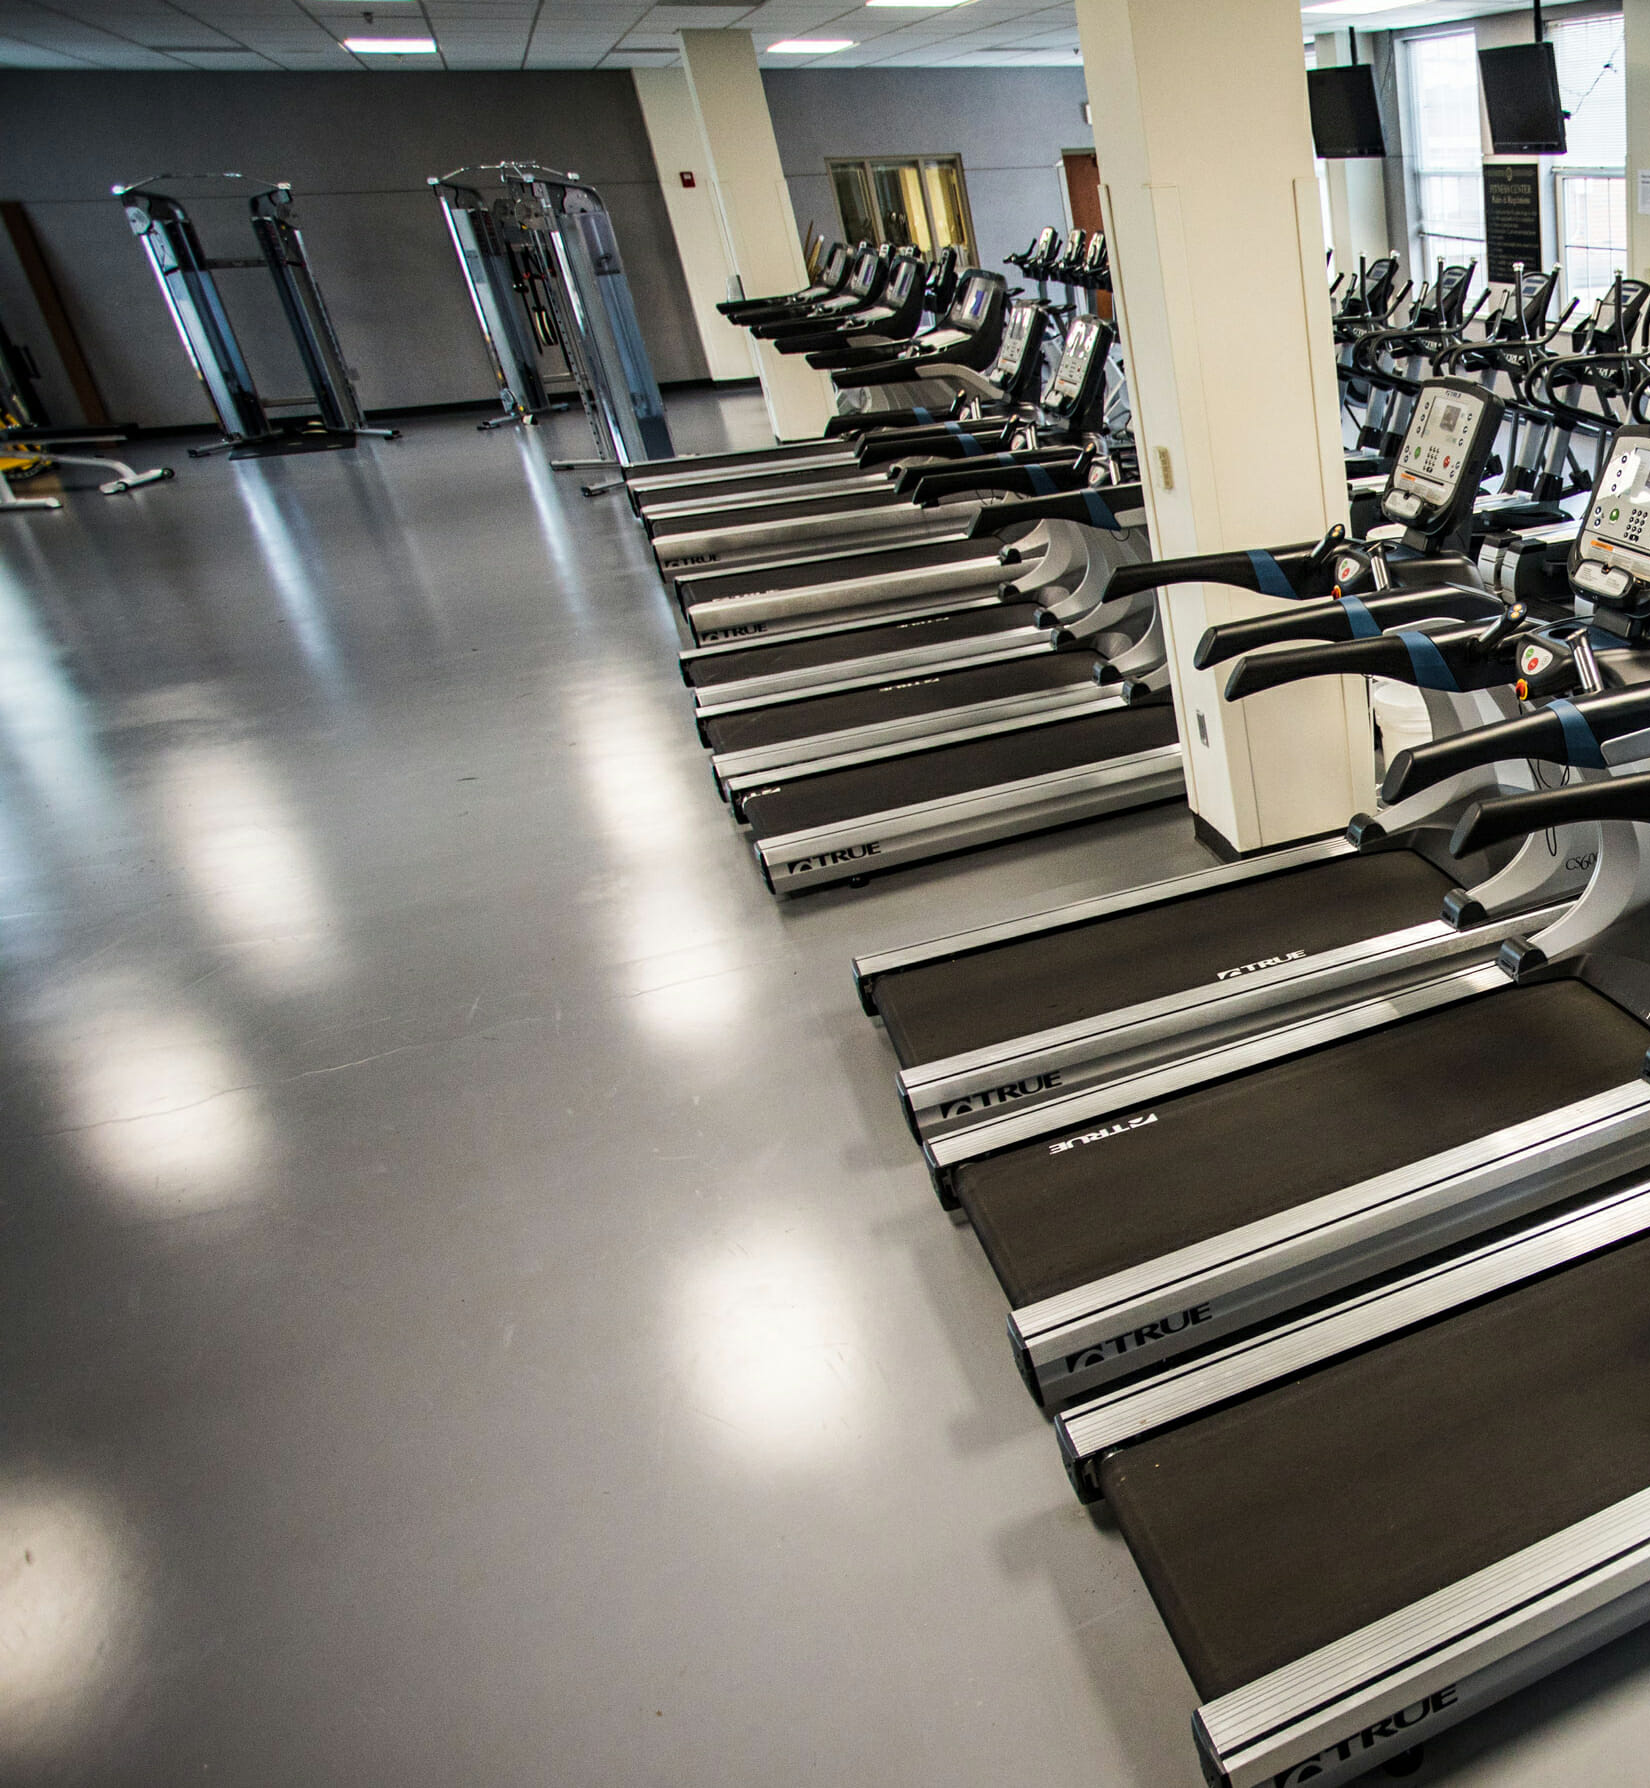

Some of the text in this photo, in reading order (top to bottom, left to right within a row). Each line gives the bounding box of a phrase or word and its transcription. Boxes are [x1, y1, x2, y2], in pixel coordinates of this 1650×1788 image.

[722, 623, 768, 638] TRUE
[815, 841, 882, 867] TRUE
[1240, 949, 1307, 972] TRUE
[979, 1070, 1063, 1107] TRUE
[1049, 1123, 1131, 1155] TRUE
[1105, 1301, 1213, 1354] TRUE
[1324, 1683, 1459, 1762] TRUE
